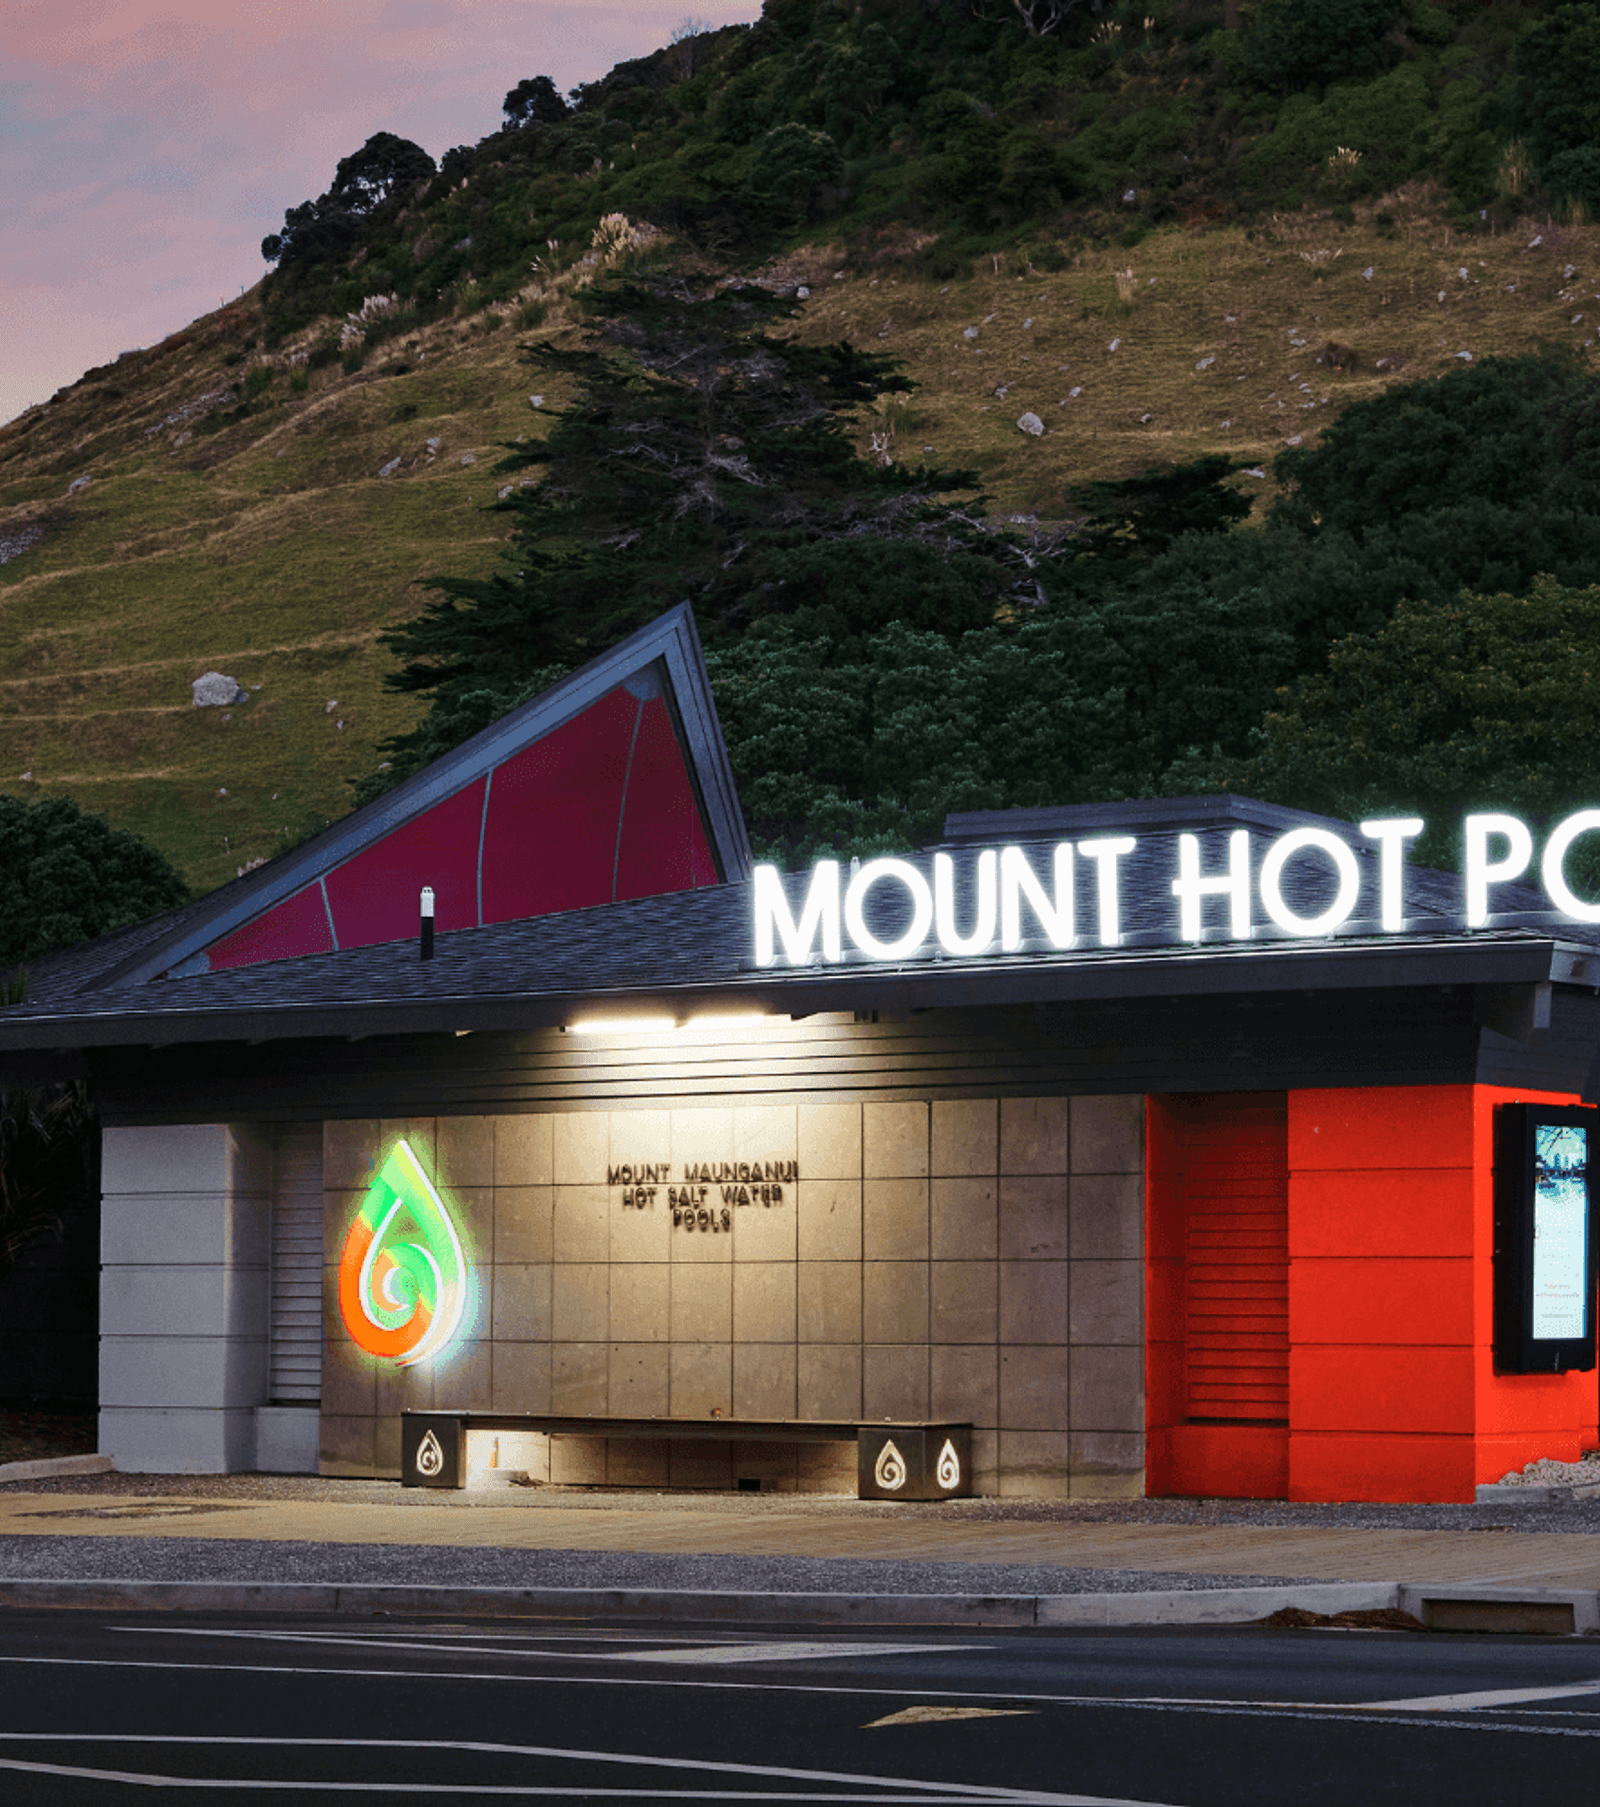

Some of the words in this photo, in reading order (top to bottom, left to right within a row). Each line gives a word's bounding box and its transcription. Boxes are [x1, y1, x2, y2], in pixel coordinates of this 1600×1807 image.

[753, 836, 1137, 967] MOUNT
[1171, 817, 1425, 942] HOT
[608, 1163, 671, 1186] MOUNT
[684, 1160, 799, 1184] MAUNGANUI
[622, 1187, 657, 1210] HOT
[667, 1186, 708, 1210] SALT
[720, 1184, 783, 1208] WATER
[672, 1208, 731, 1233] POOLS
